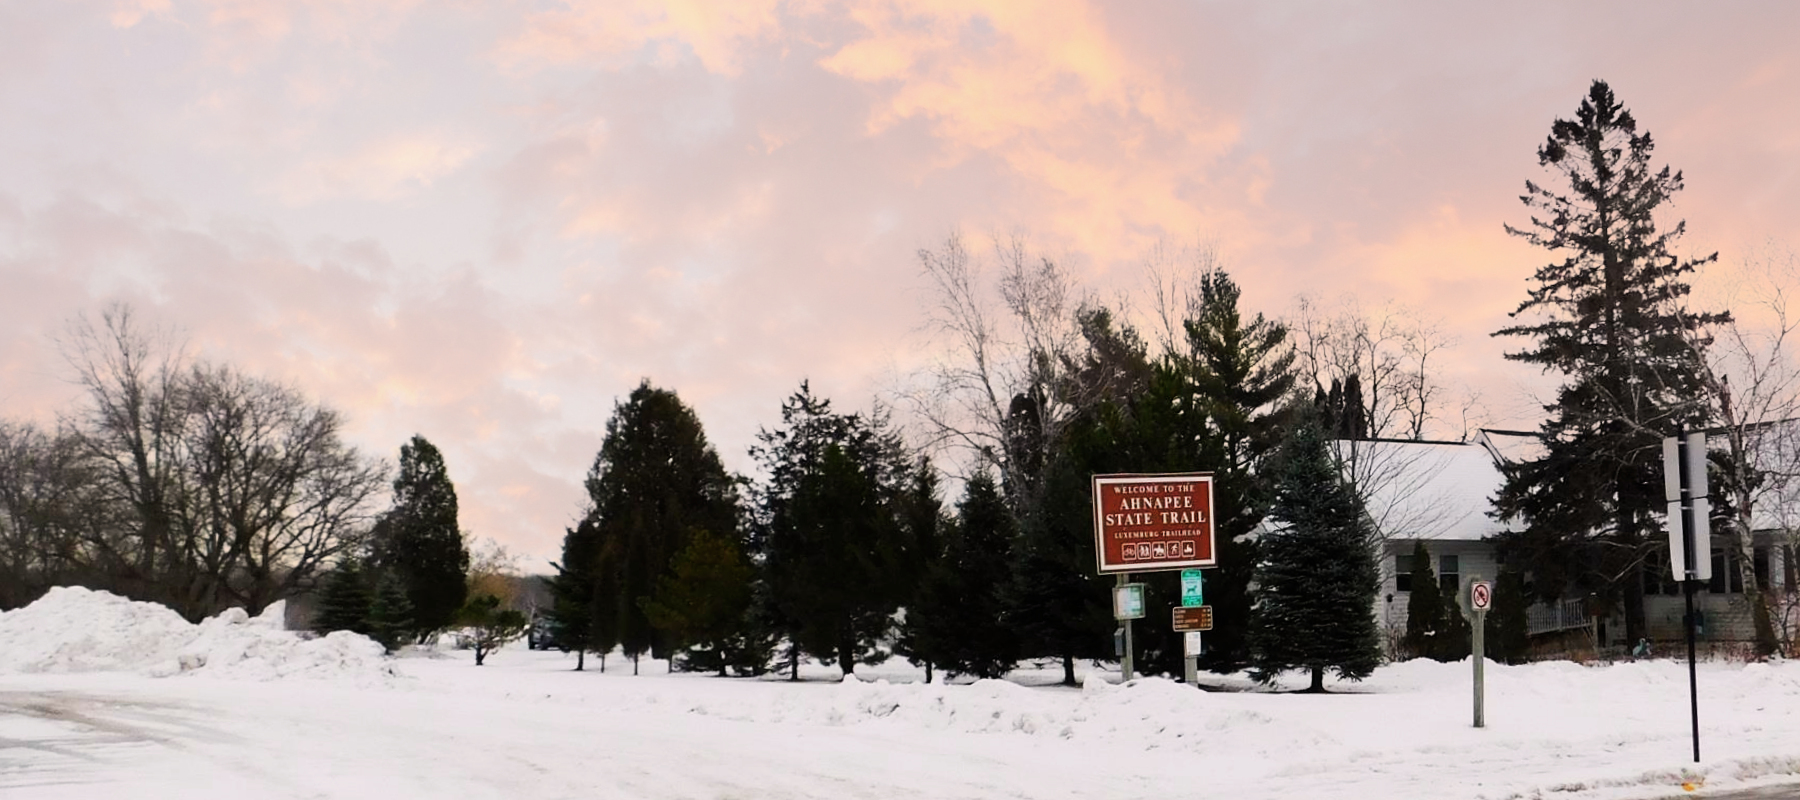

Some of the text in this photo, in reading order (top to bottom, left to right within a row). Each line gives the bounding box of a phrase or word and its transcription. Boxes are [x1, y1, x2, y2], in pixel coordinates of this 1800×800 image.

[1114, 484, 1195, 494] WELCOME TO THE
[1120, 496, 1192, 510] AHNAPEE
[1105, 511, 1206, 526] STATE TRAIL
[1114, 529, 1201, 539] LUXEMBURG TRAILHEAD
